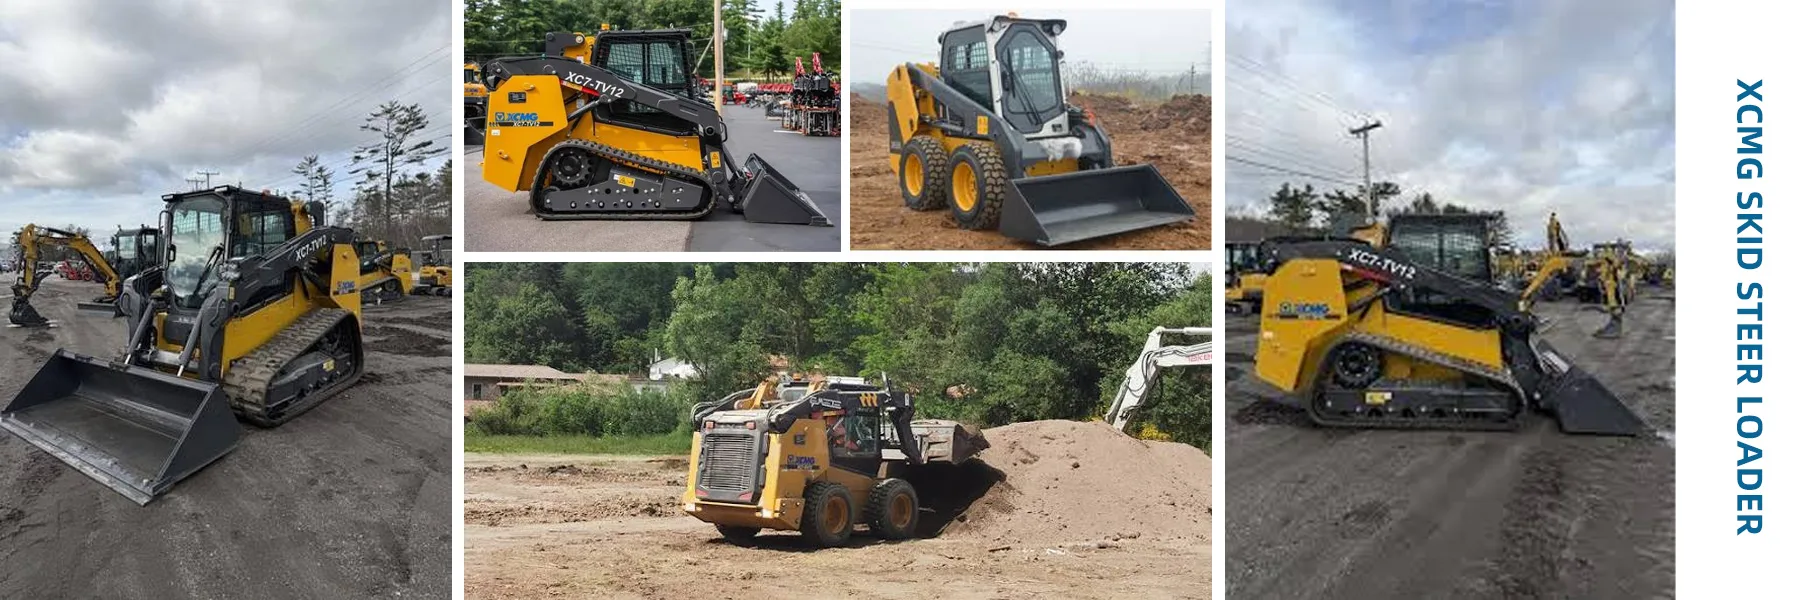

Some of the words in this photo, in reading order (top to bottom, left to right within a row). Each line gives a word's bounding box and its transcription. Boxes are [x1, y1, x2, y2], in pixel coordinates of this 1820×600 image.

[565, 71, 624, 98] XC7-TV12
[506, 112, 539, 121] XCMG
[295, 234, 327, 261] XC7-TV12
[1349, 249, 1416, 279] XC7-TV12
